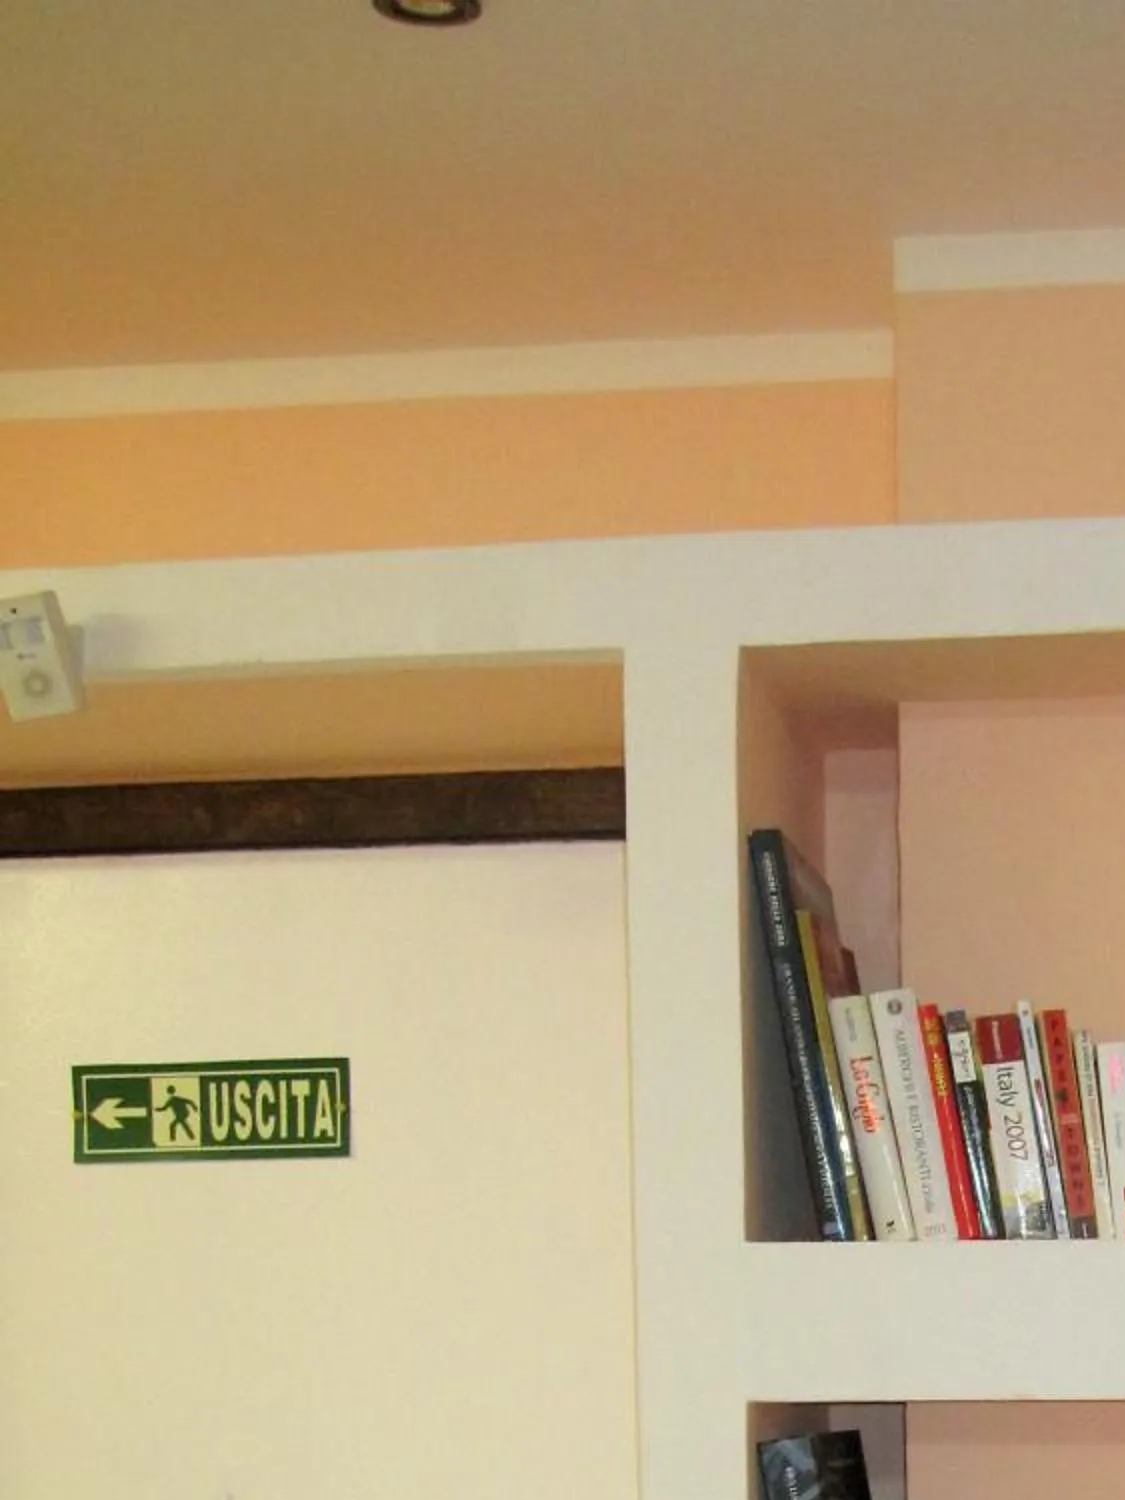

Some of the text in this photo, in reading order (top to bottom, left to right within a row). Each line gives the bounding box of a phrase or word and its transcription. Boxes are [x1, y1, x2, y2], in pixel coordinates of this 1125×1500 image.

[208, 1078, 335, 1142] USCITA
[908, 1105, 931, 1181] RISTORANTI
[996, 1066, 1029, 1161] Italy 2007
